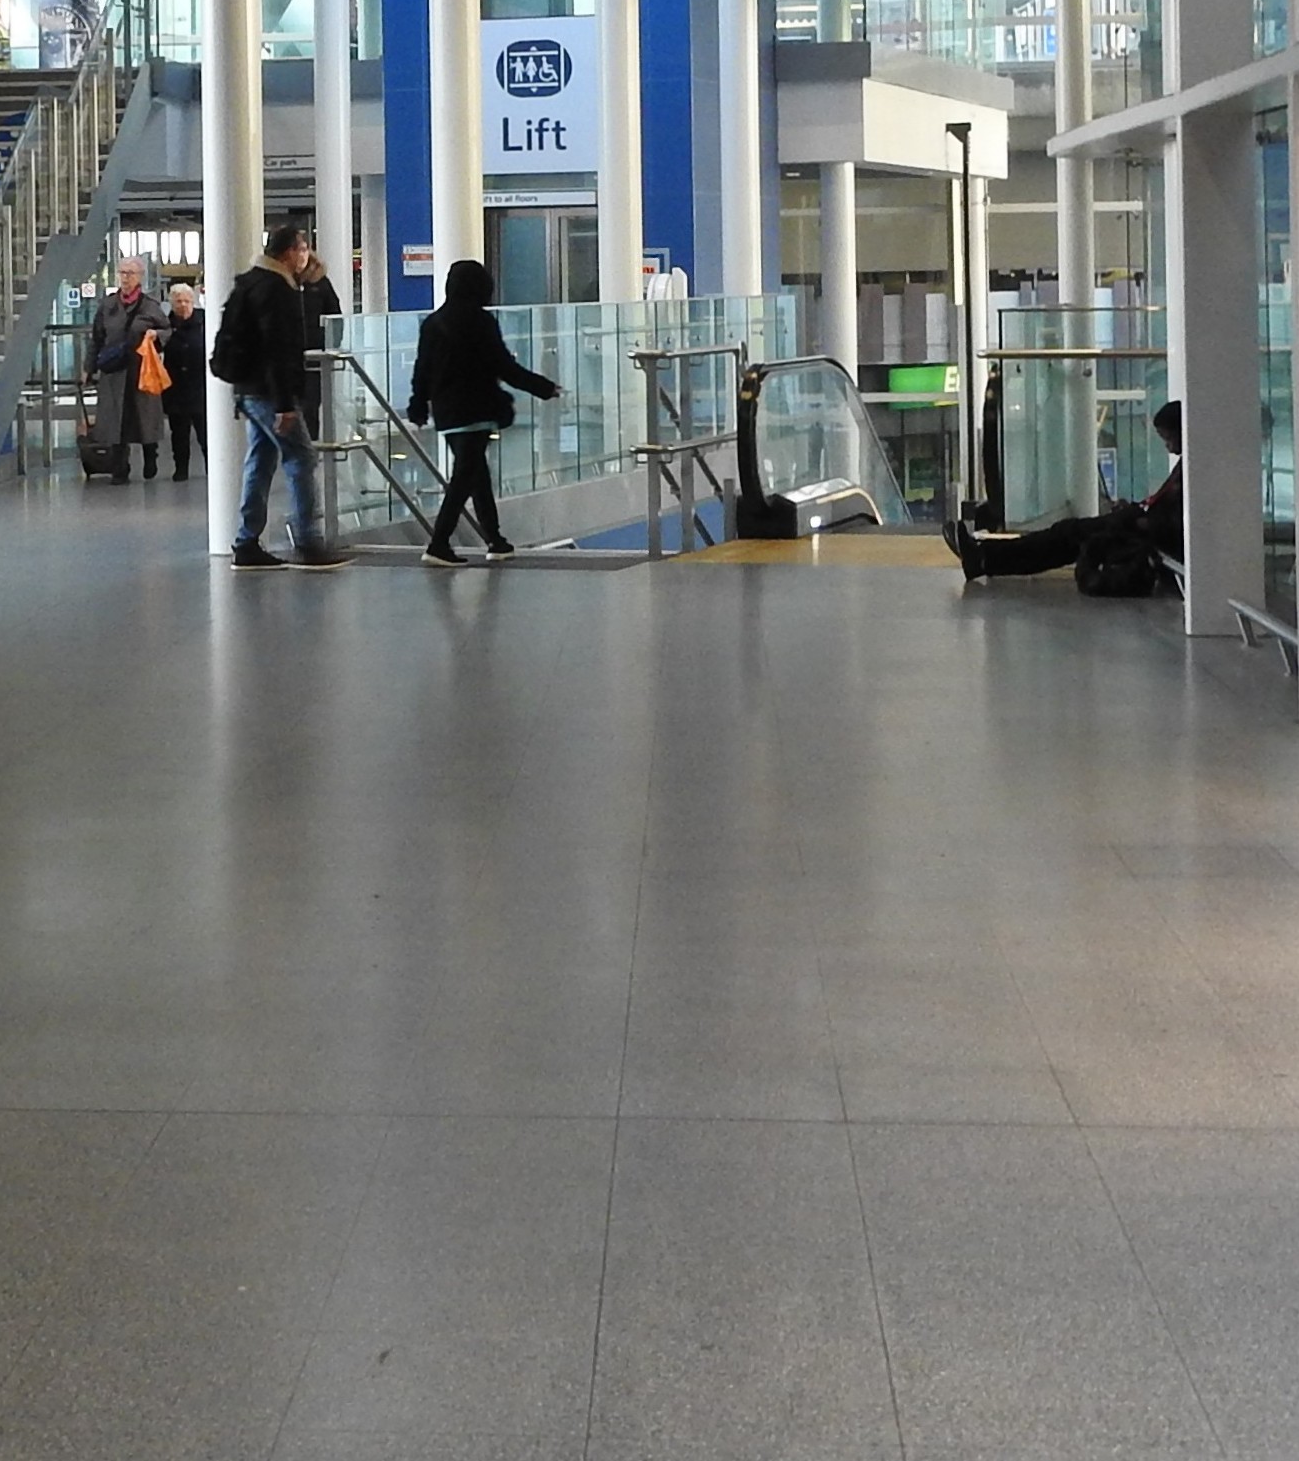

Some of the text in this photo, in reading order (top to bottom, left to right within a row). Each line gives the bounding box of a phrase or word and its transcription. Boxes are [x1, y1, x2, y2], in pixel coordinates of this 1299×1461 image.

[503, 117, 567, 152] Lift
[280, 158, 298, 169] park
[494, 195, 502, 204] to
[504, 194, 513, 203] all
[515, 193, 539, 203] floors
